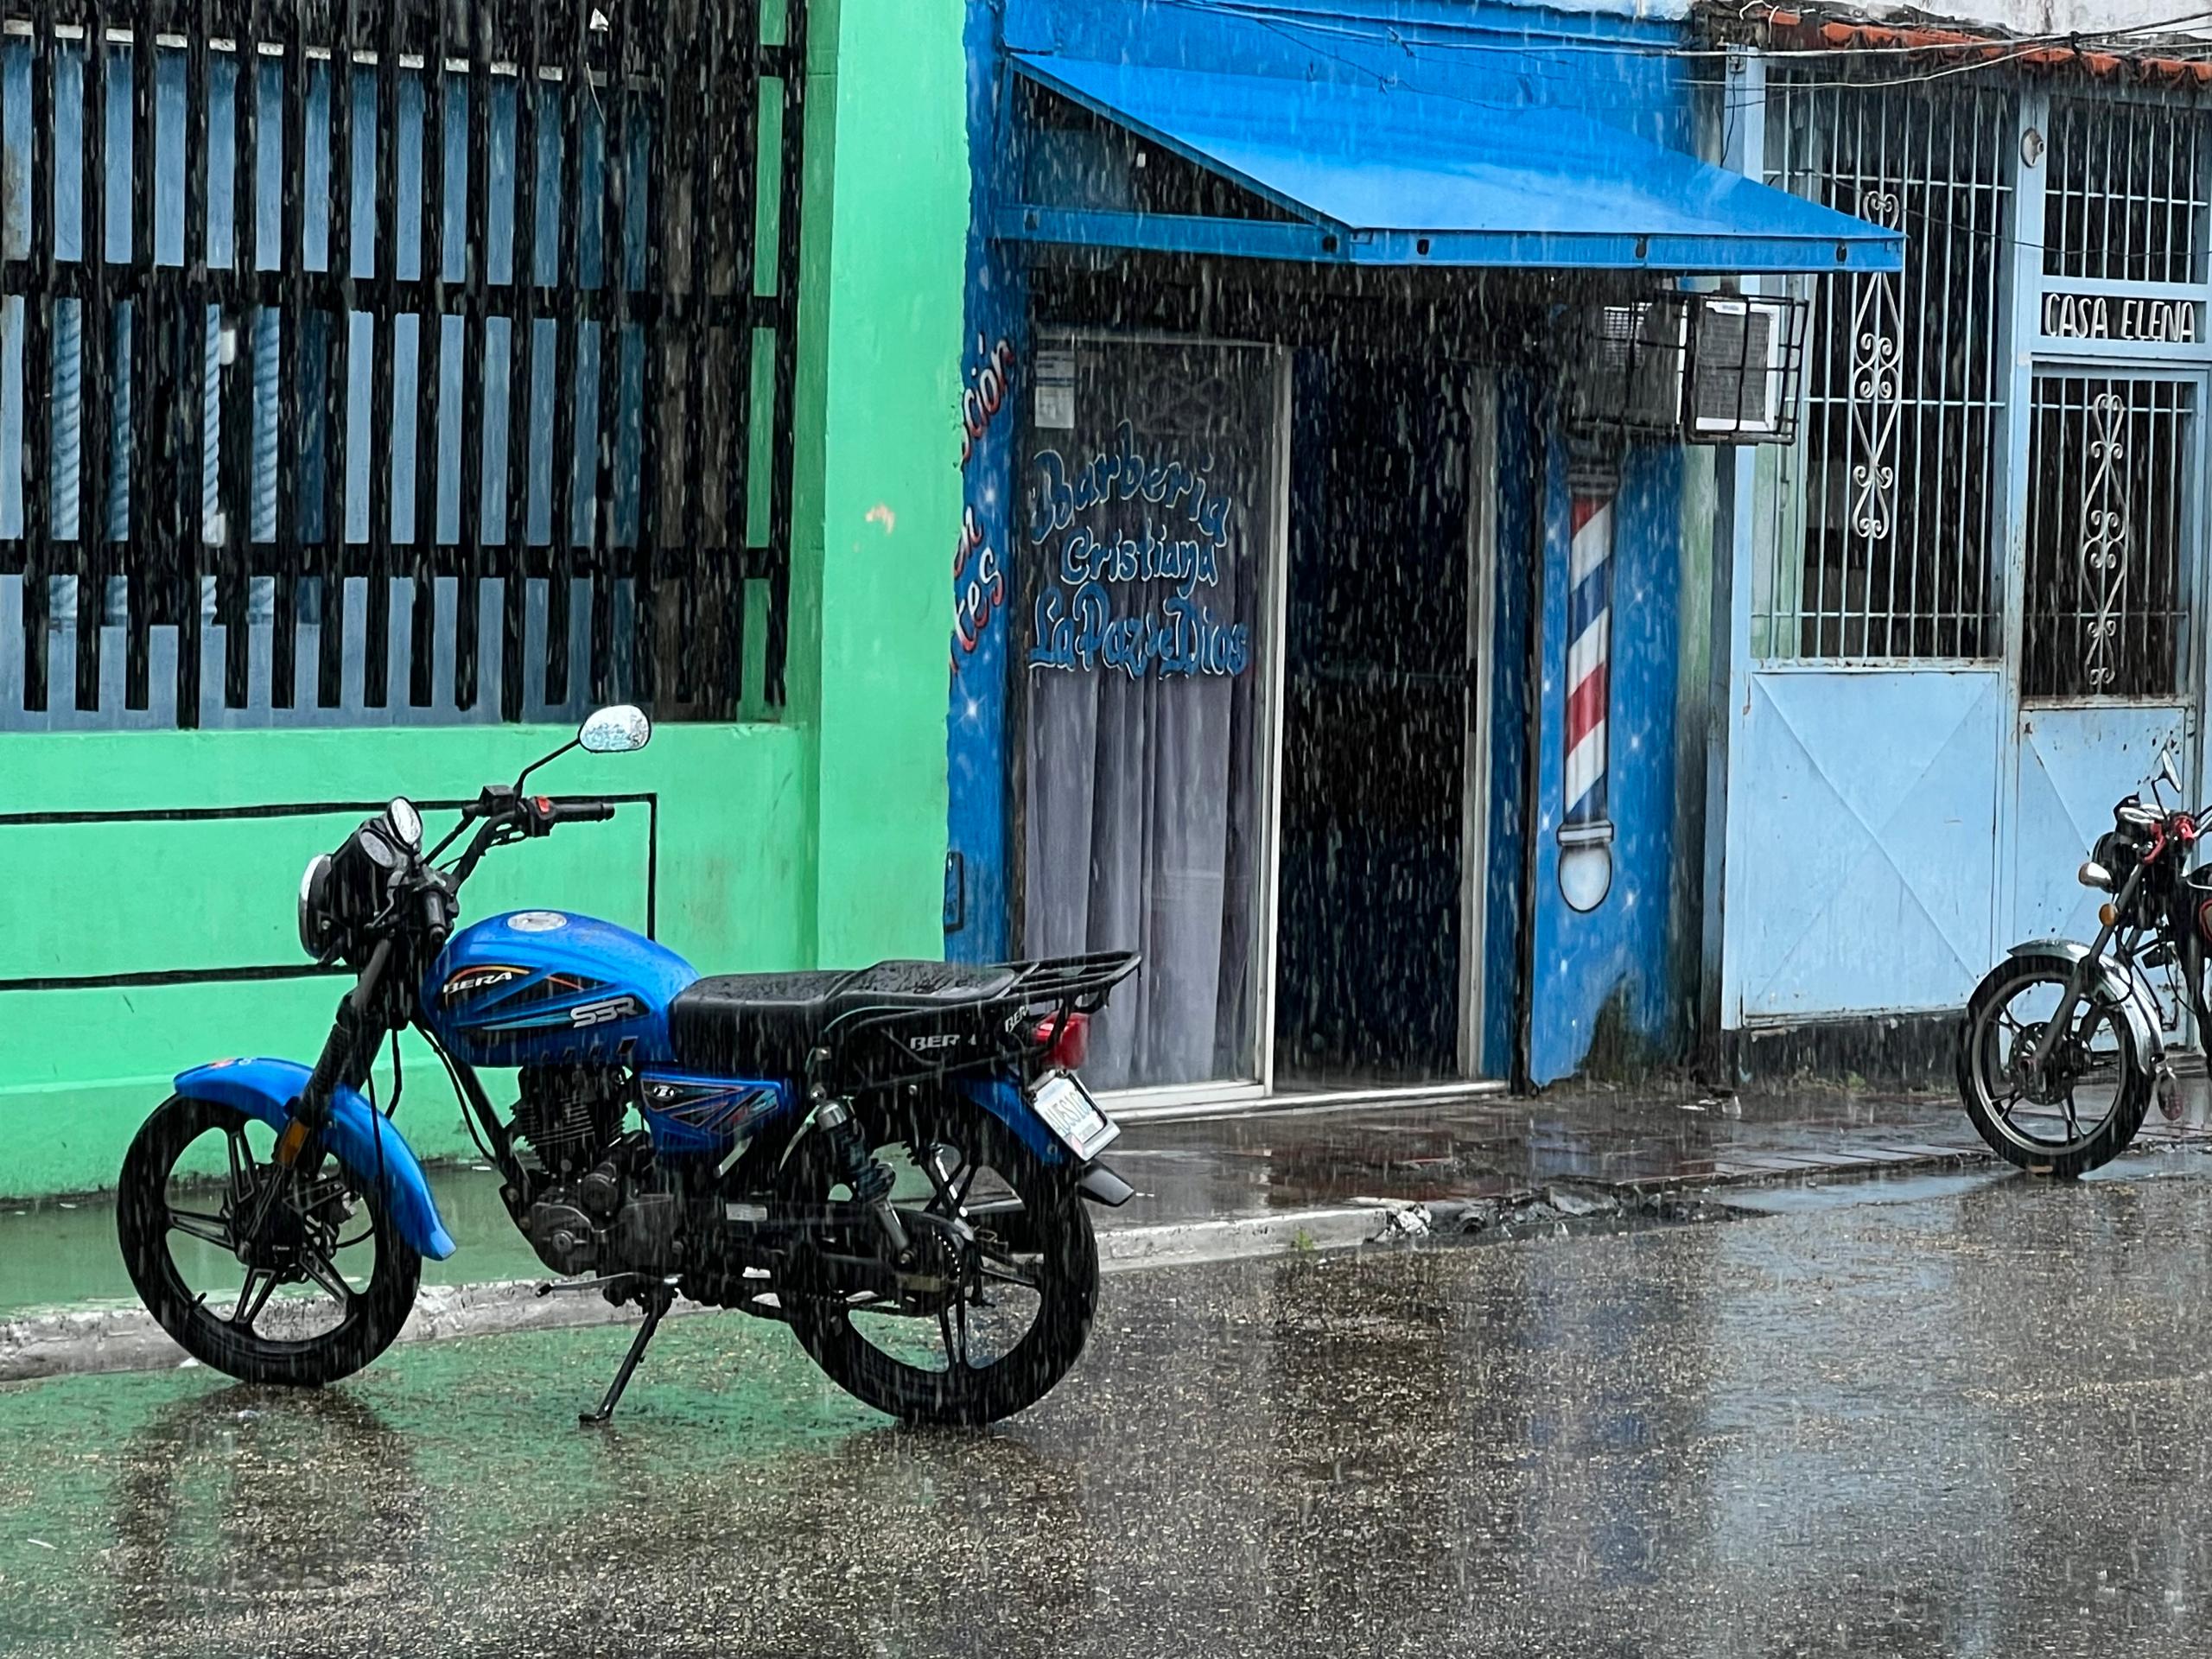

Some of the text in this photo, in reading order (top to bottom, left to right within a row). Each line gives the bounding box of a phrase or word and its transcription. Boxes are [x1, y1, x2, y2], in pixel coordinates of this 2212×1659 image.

[2044, 293, 2196, 344] CASA ELENA
[442, 971, 512, 995] BERA
